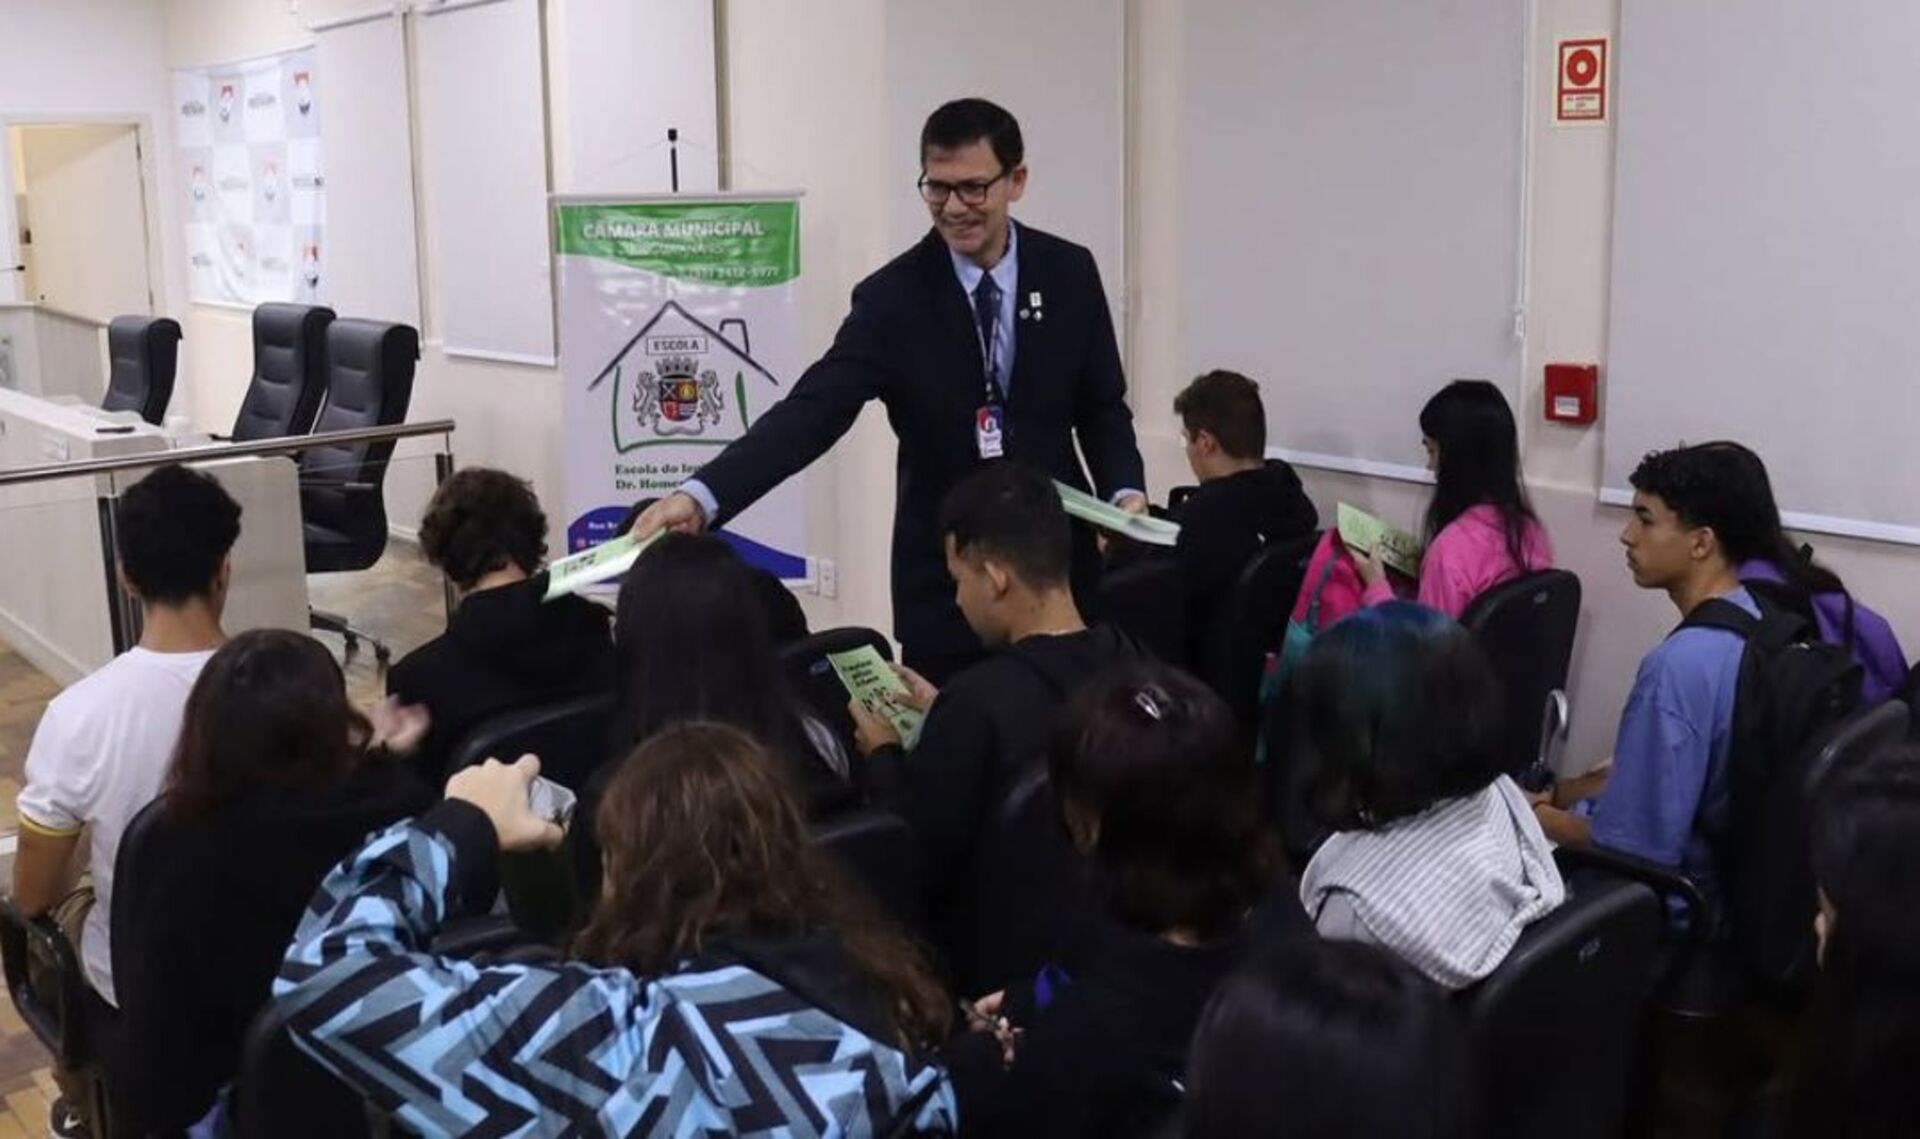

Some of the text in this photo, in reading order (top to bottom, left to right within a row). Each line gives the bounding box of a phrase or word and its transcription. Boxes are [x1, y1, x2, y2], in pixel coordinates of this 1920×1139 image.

[662, 221, 765, 236] MUNICIPAL
[653, 340, 699, 351] ESCOLA
[615, 463, 658, 474] Escola
[661, 463, 679, 474] do
[615, 480, 636, 490] Dr.
